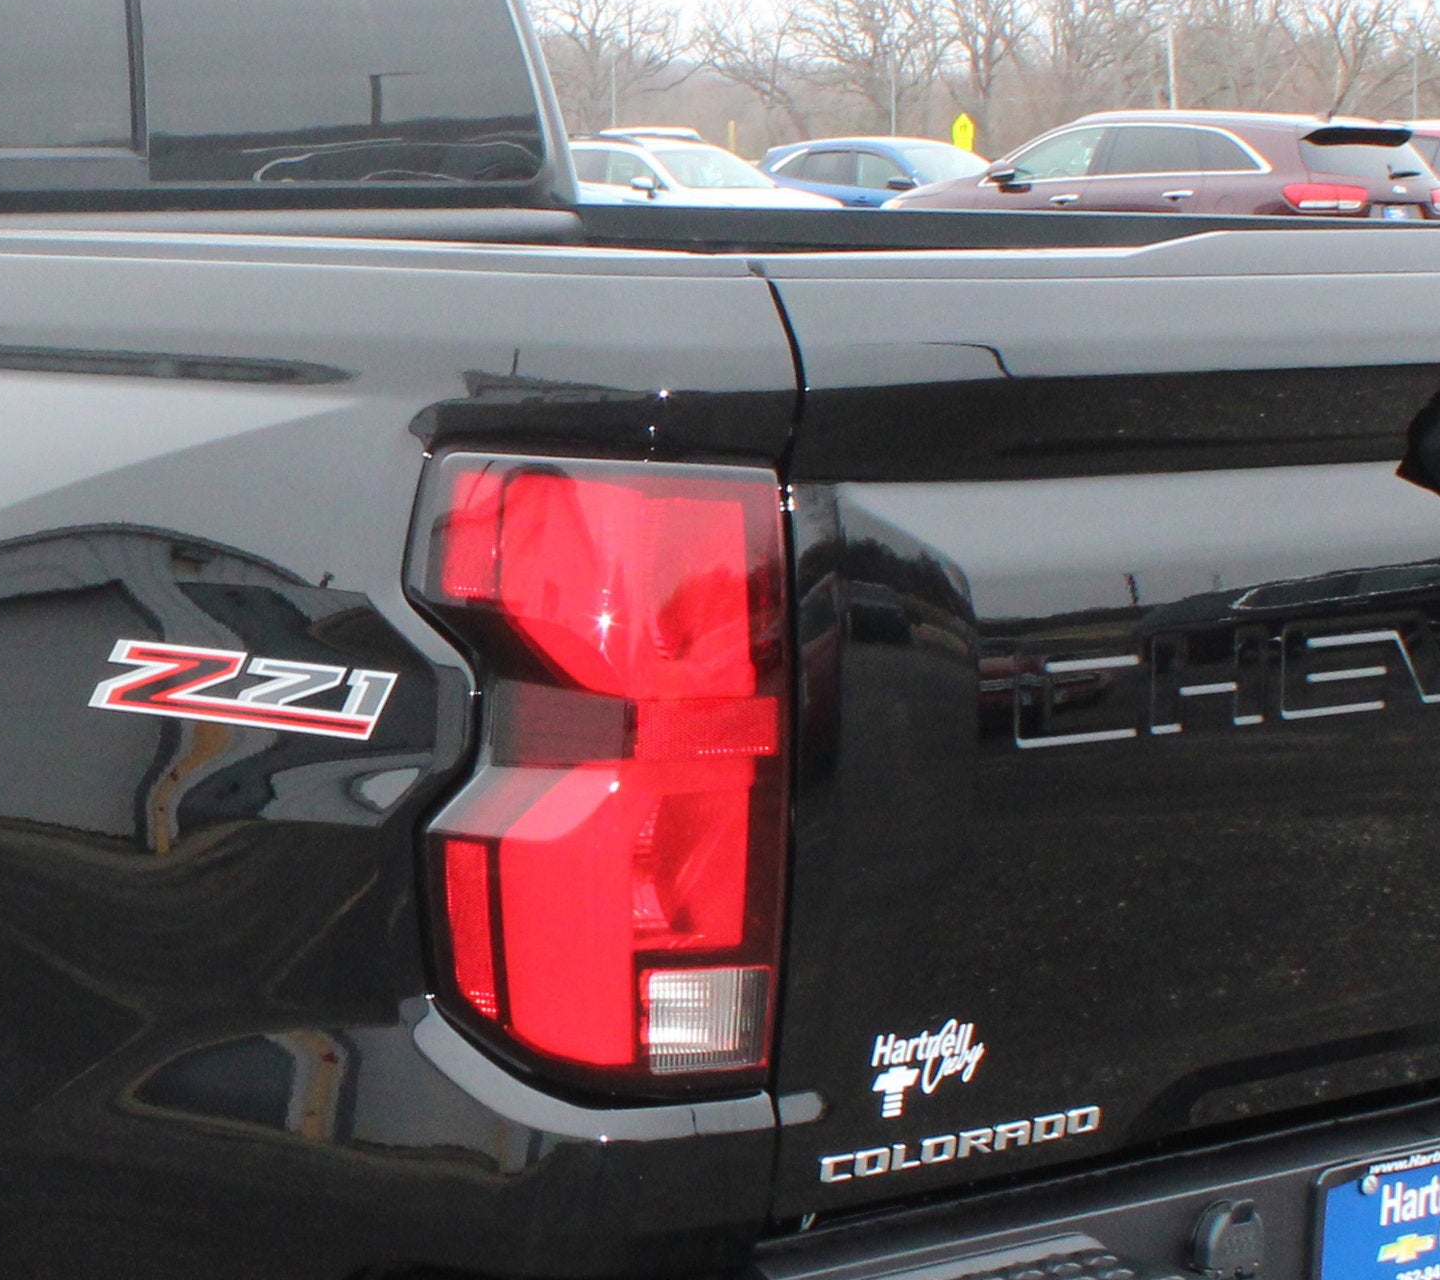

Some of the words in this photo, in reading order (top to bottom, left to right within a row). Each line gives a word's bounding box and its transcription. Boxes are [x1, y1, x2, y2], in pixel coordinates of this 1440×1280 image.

[87, 639, 399, 741] Z71
[871, 1022, 974, 1067] Hartnell
[921, 1018, 985, 1094] Chevy
[820, 1105, 1101, 1183] COLORADO
